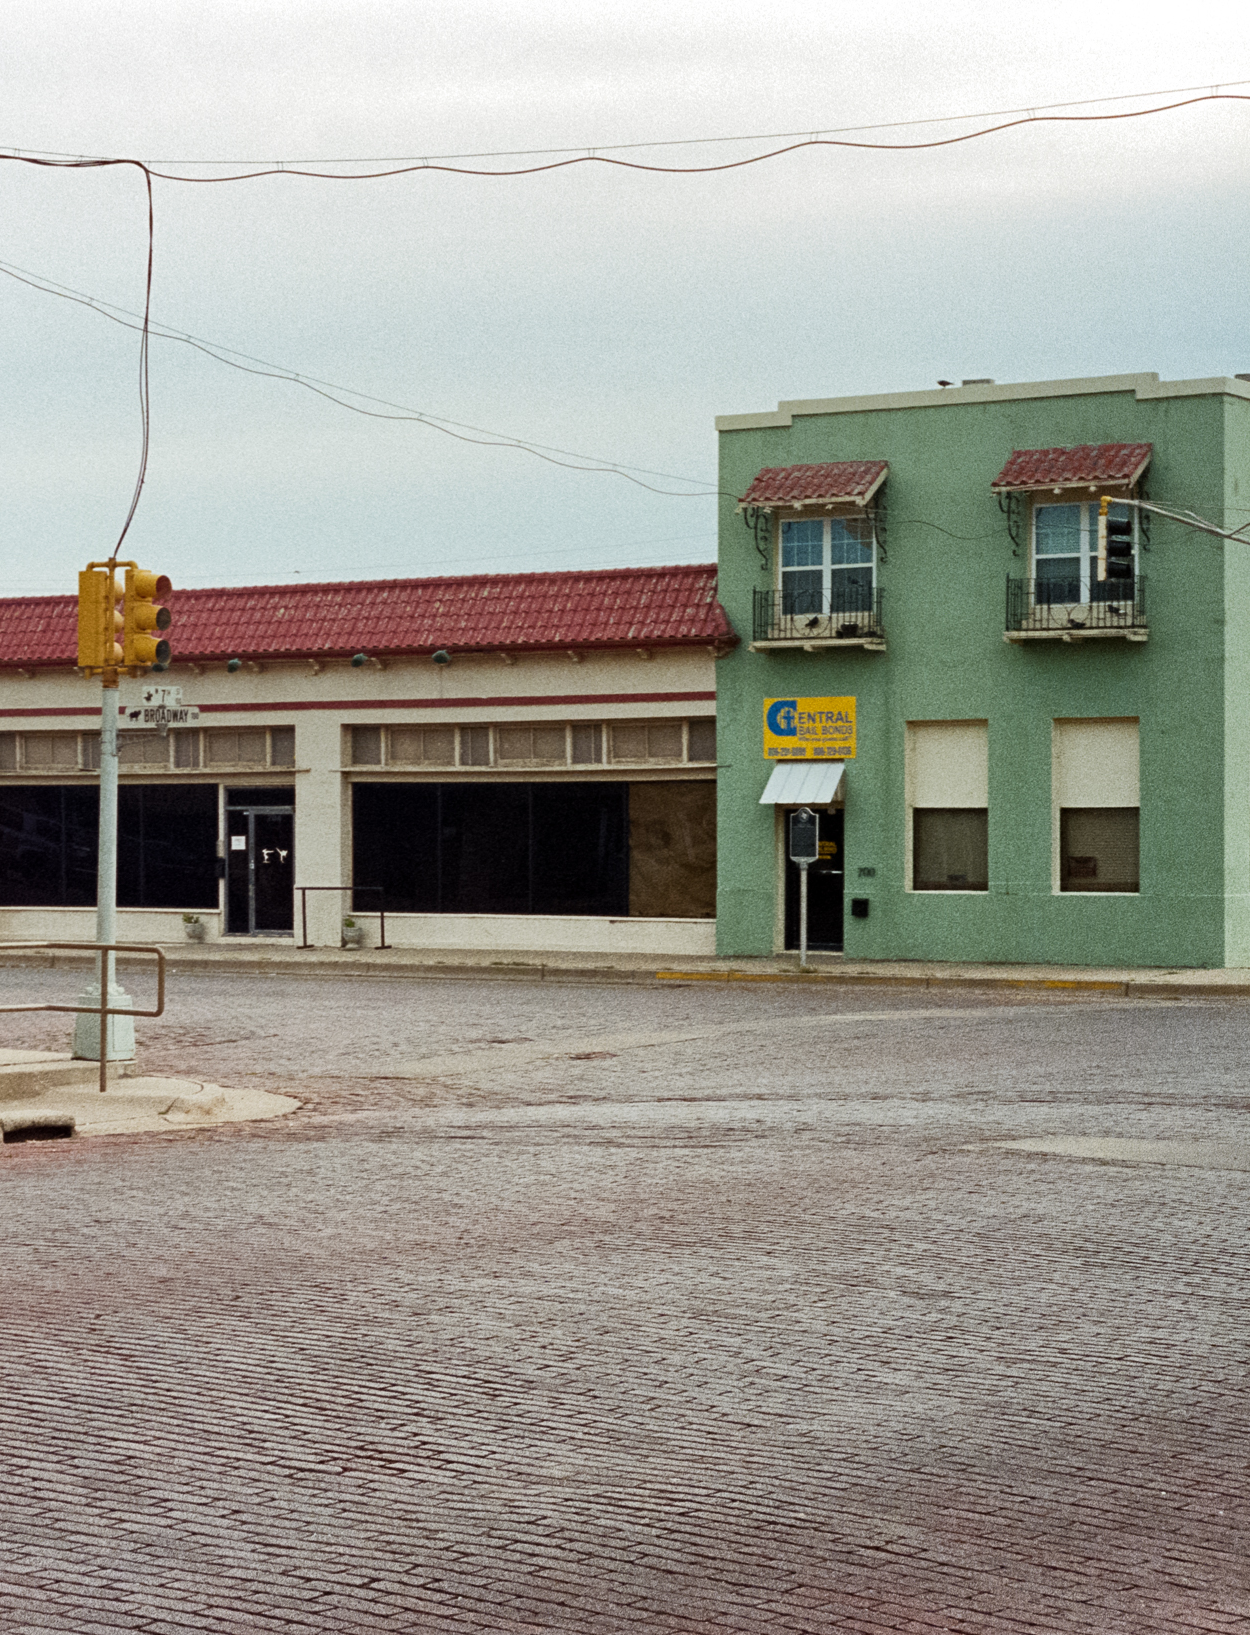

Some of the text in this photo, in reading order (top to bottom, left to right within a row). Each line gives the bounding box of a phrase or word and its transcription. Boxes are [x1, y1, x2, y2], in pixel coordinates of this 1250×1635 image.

[144, 708, 189, 723] BROADWAY
[798, 725, 853, 736] BAIL BONDS
